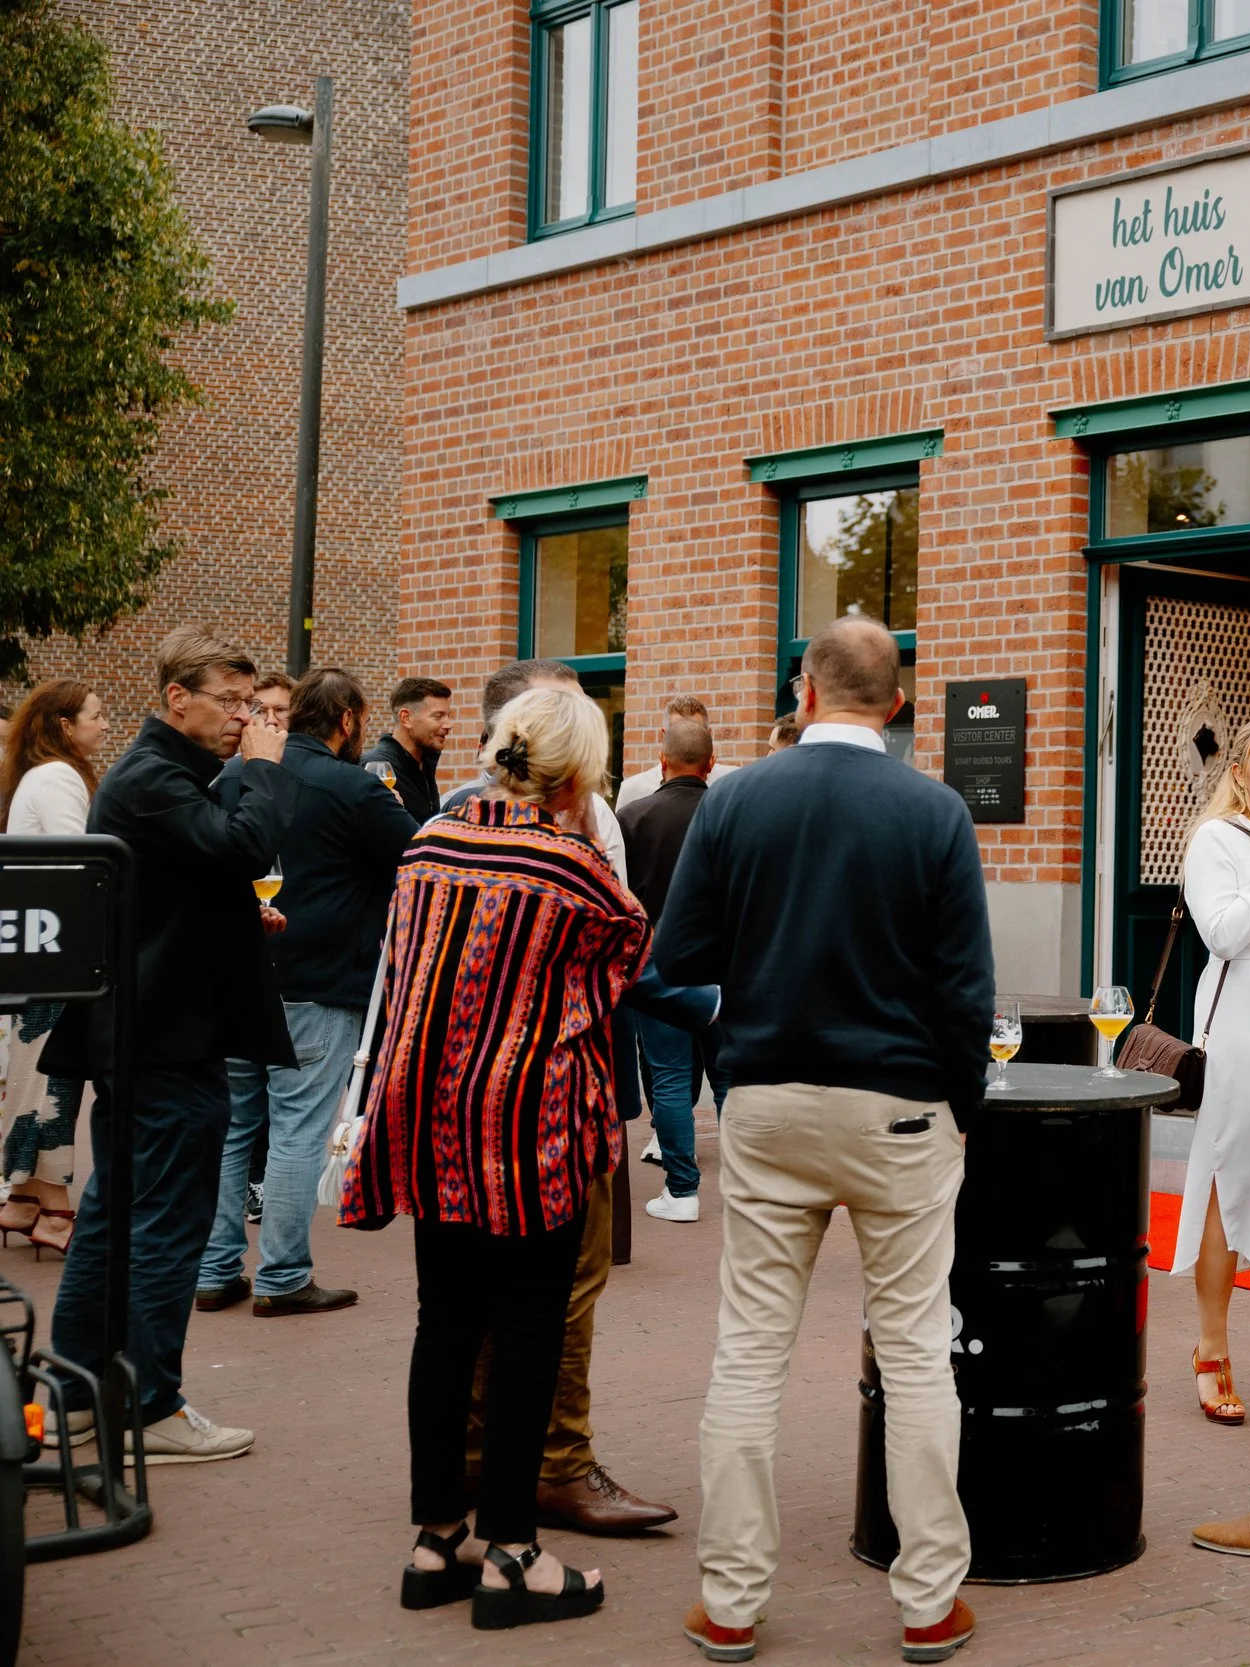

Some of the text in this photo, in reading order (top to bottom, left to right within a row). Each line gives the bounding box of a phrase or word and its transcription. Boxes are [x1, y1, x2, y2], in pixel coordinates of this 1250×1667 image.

[1112, 186, 1226, 248] het huis
[1095, 244, 1243, 311] van Omer
[967, 705, 1000, 719] OMER.
[953, 730, 1016, 743] VISITOR CENTER
